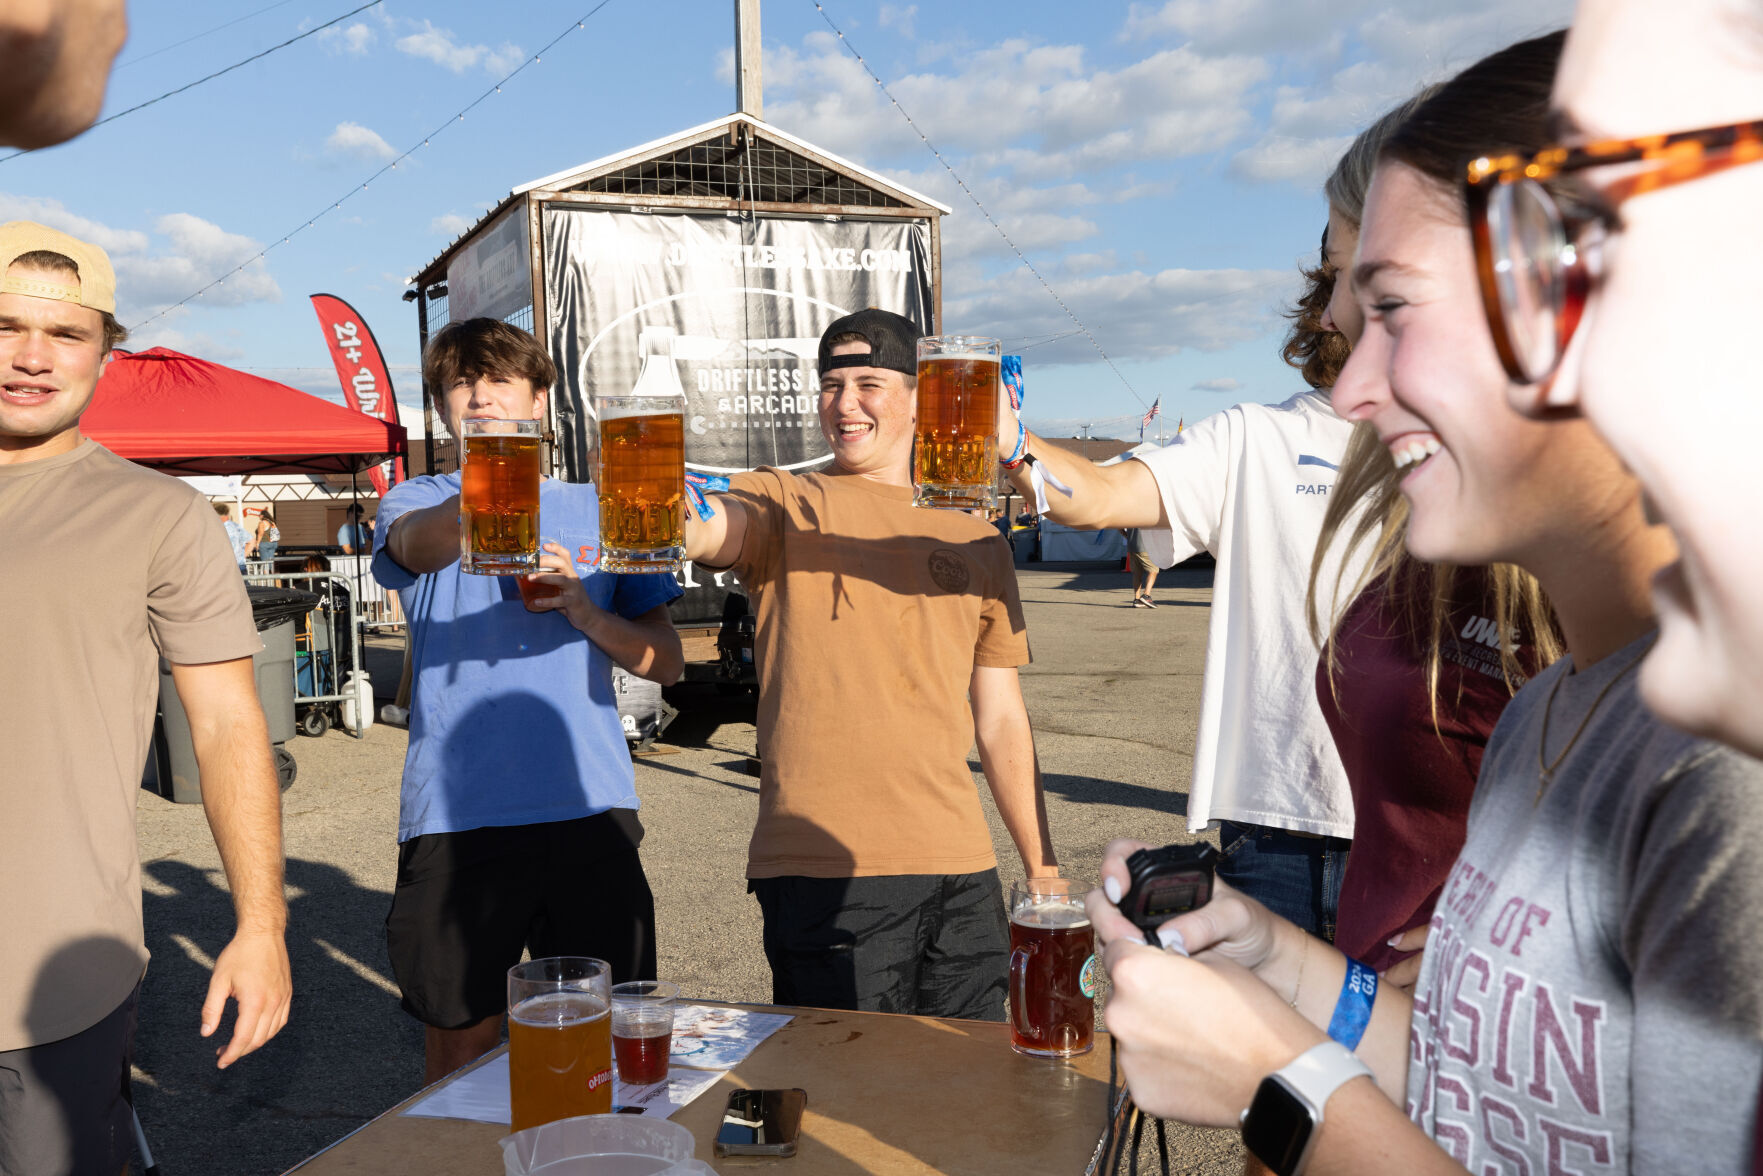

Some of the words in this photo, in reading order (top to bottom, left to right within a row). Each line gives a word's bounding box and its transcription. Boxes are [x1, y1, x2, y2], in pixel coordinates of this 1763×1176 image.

[333, 321, 362, 363] 21+
[697, 368, 803, 392] DRIFTLESS
[1489, 896, 1552, 957] OF
[1362, 973, 1375, 996] GA
